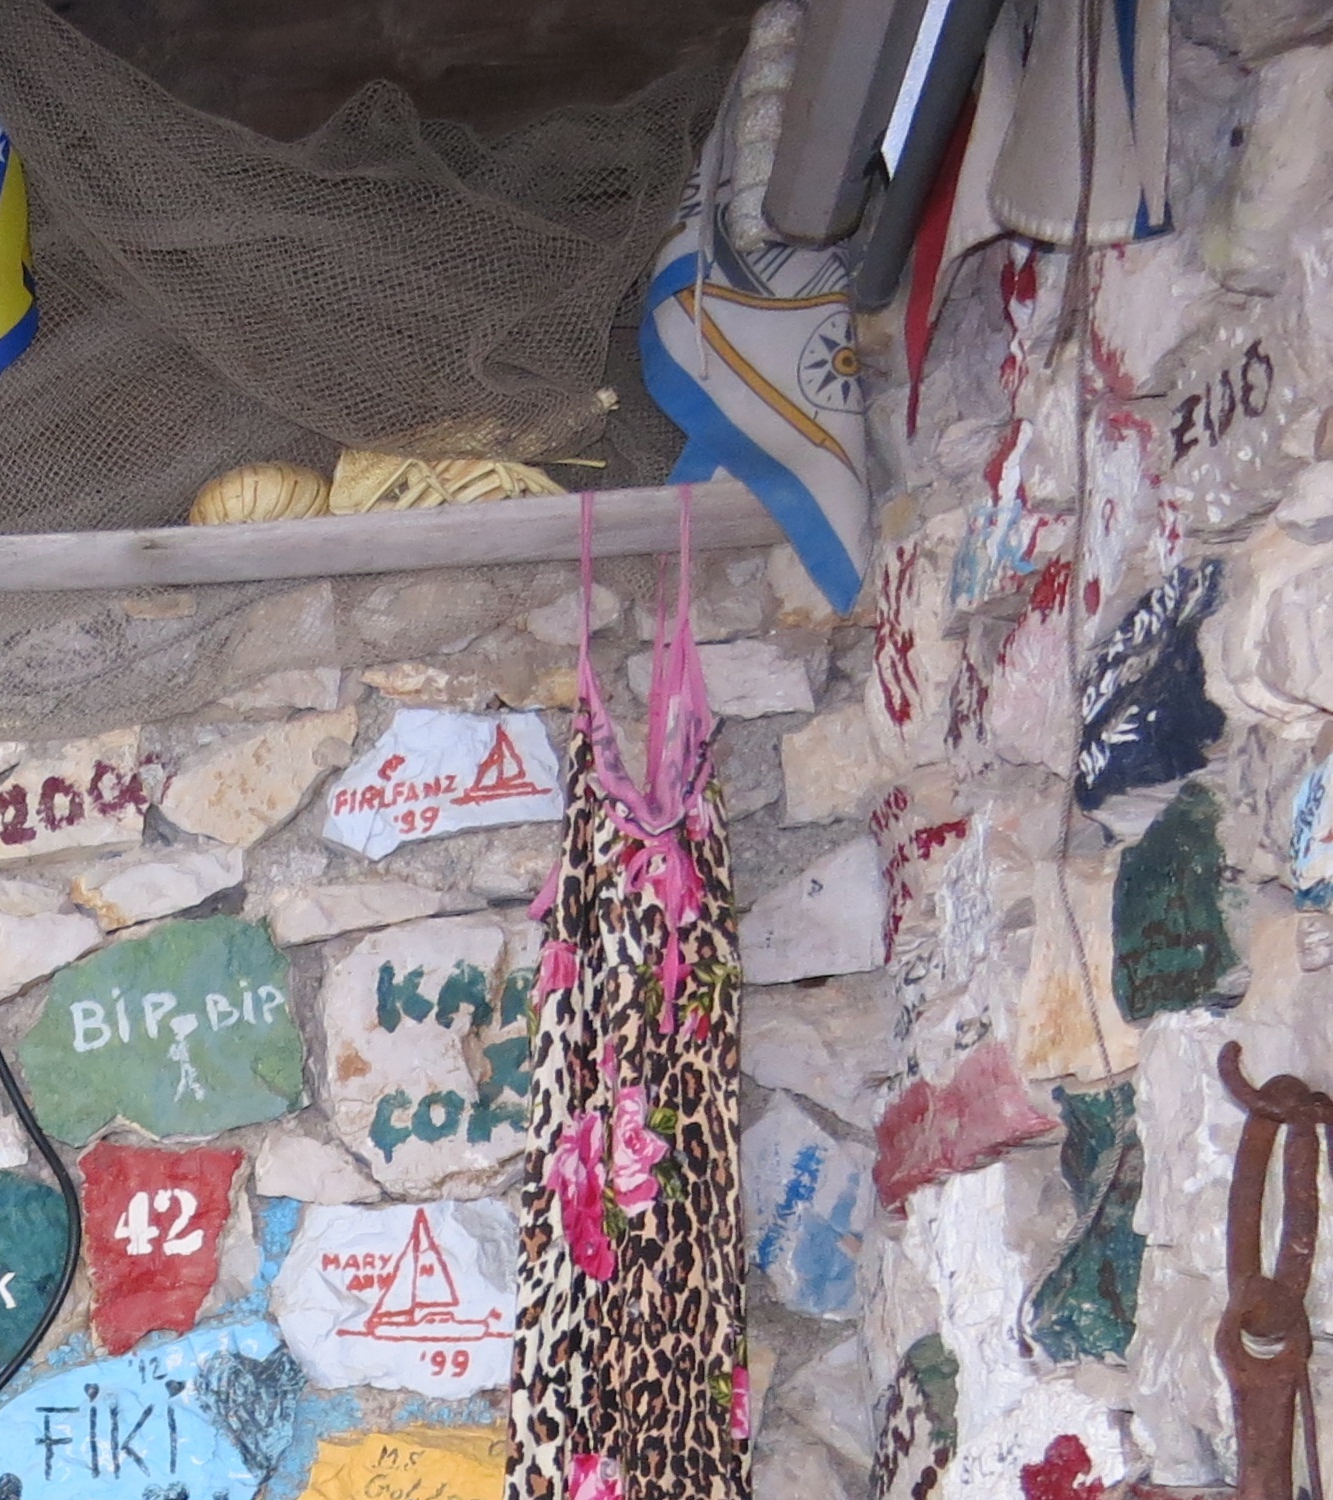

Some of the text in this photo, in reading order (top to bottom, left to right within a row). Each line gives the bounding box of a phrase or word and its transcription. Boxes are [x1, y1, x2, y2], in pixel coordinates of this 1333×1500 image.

[113, 1188, 205, 1257] 42
[321, 1252, 393, 1274] MARY
[418, 1348, 471, 1379] '99
